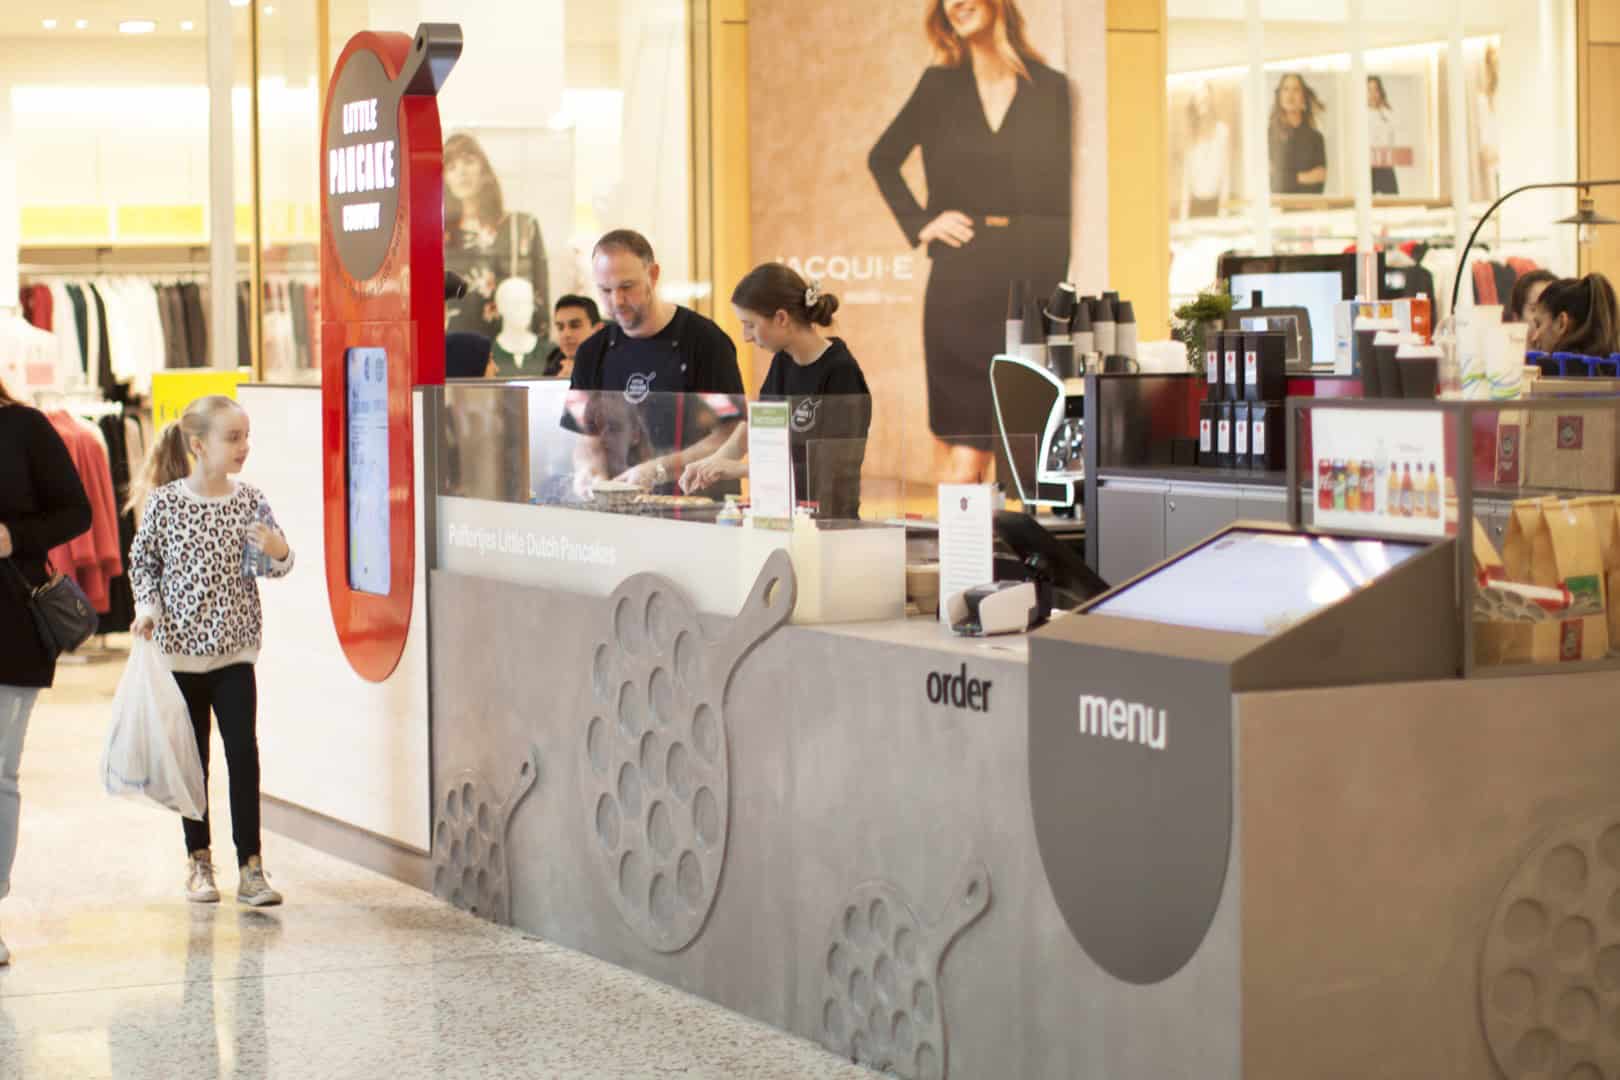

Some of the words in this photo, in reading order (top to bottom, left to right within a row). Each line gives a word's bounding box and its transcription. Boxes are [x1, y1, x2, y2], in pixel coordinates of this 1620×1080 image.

[342, 98, 377, 135] LITTLE
[329, 140, 395, 195] PANCAKE
[498, 528, 525, 555] Little
[527, 531, 560, 560] Dutch
[561, 535, 616, 566] Pancakes
[926, 662, 992, 713] order
[1079, 694, 1166, 750] menu
